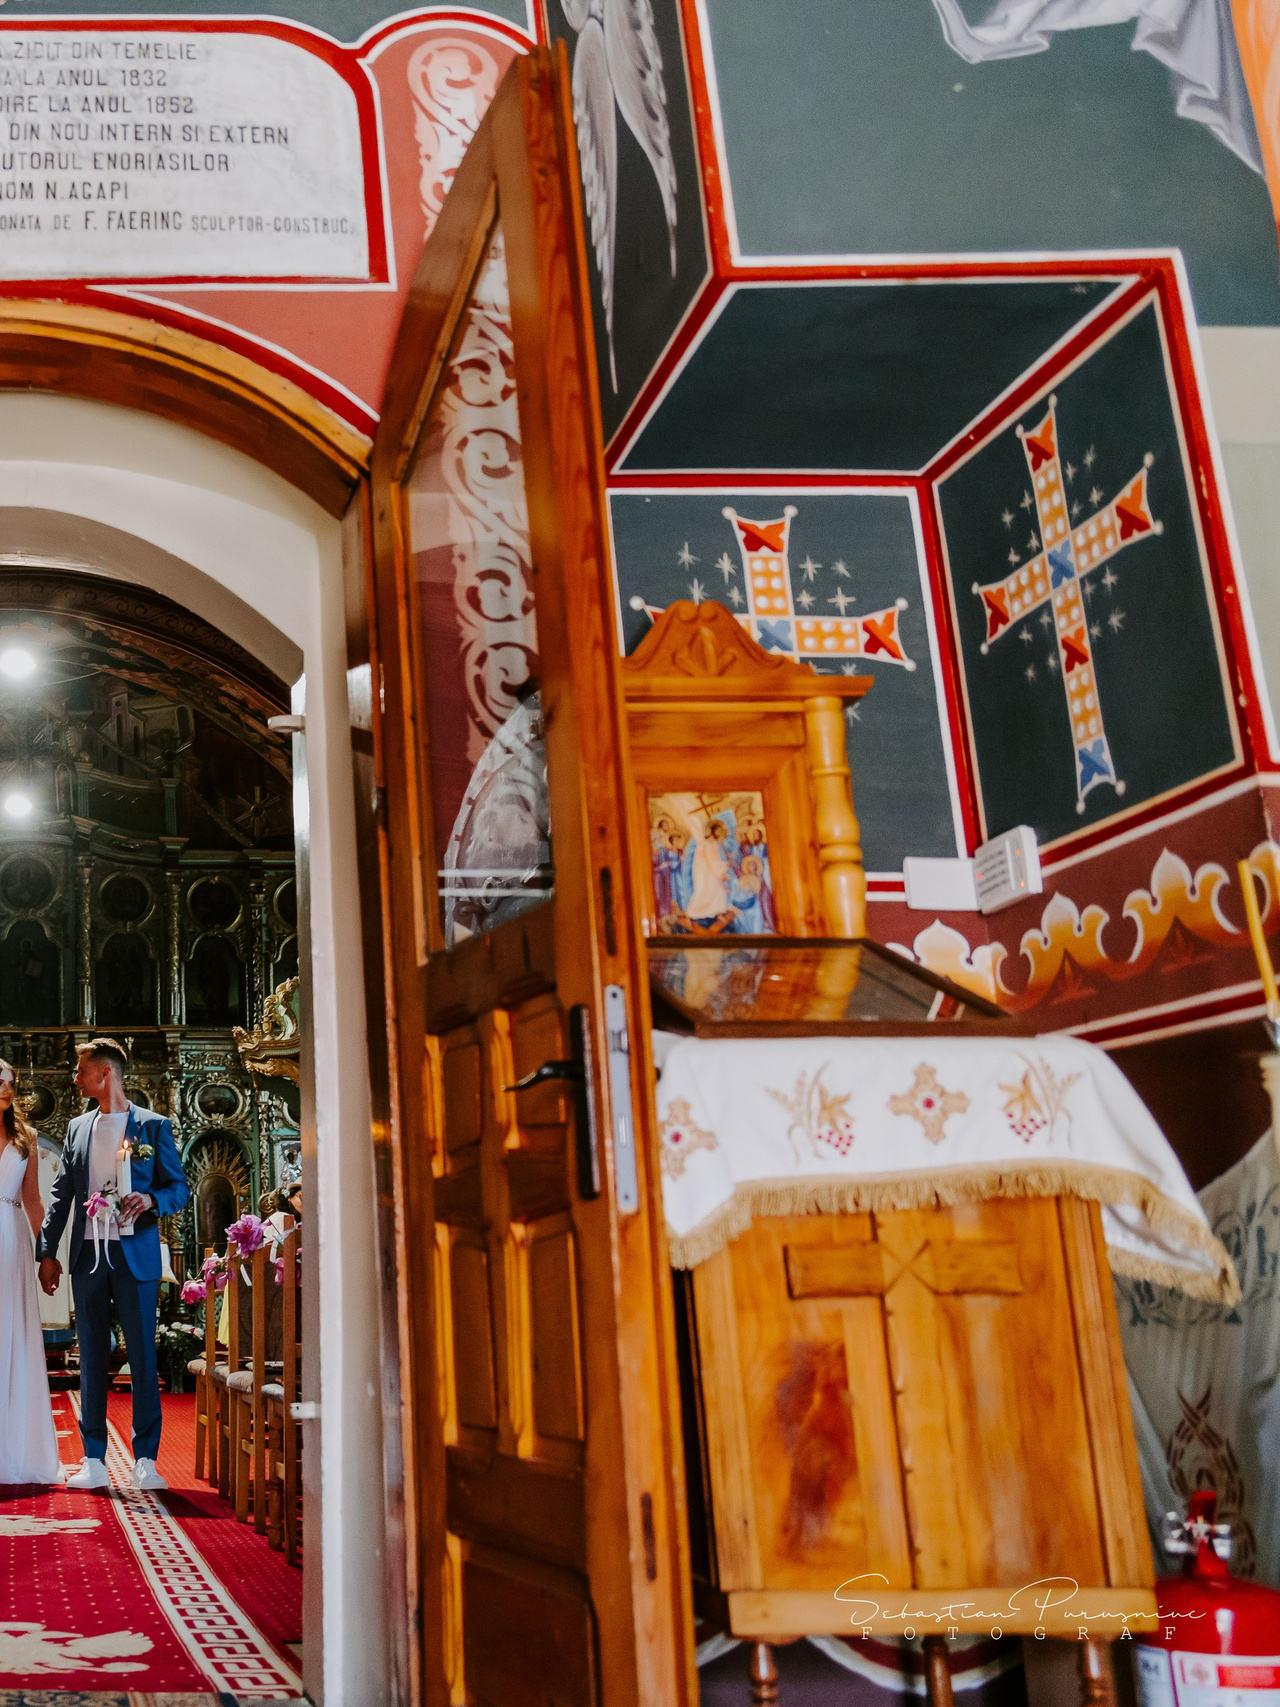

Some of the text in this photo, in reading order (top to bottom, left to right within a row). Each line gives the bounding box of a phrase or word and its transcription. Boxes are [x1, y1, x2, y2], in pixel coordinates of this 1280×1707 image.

[72, 43, 103, 60] DIN
[113, 43, 197, 60] TEMELIE
[24, 69, 46, 86] LA
[56, 69, 108, 86] ANUL
[122, 69, 167, 86] 1832
[49, 96, 72, 113] LA
[81, 96, 132, 113] ANUL
[147, 96, 194, 114] 1852
[9, 123, 40, 141] DIN
[51, 123, 89, 141] NOU
[100, 123, 172, 142] INTERN
[182, 124, 200, 142] SI
[210, 125, 289, 145] EXTERN
[93, 152, 230, 172] ENORIASILOR
